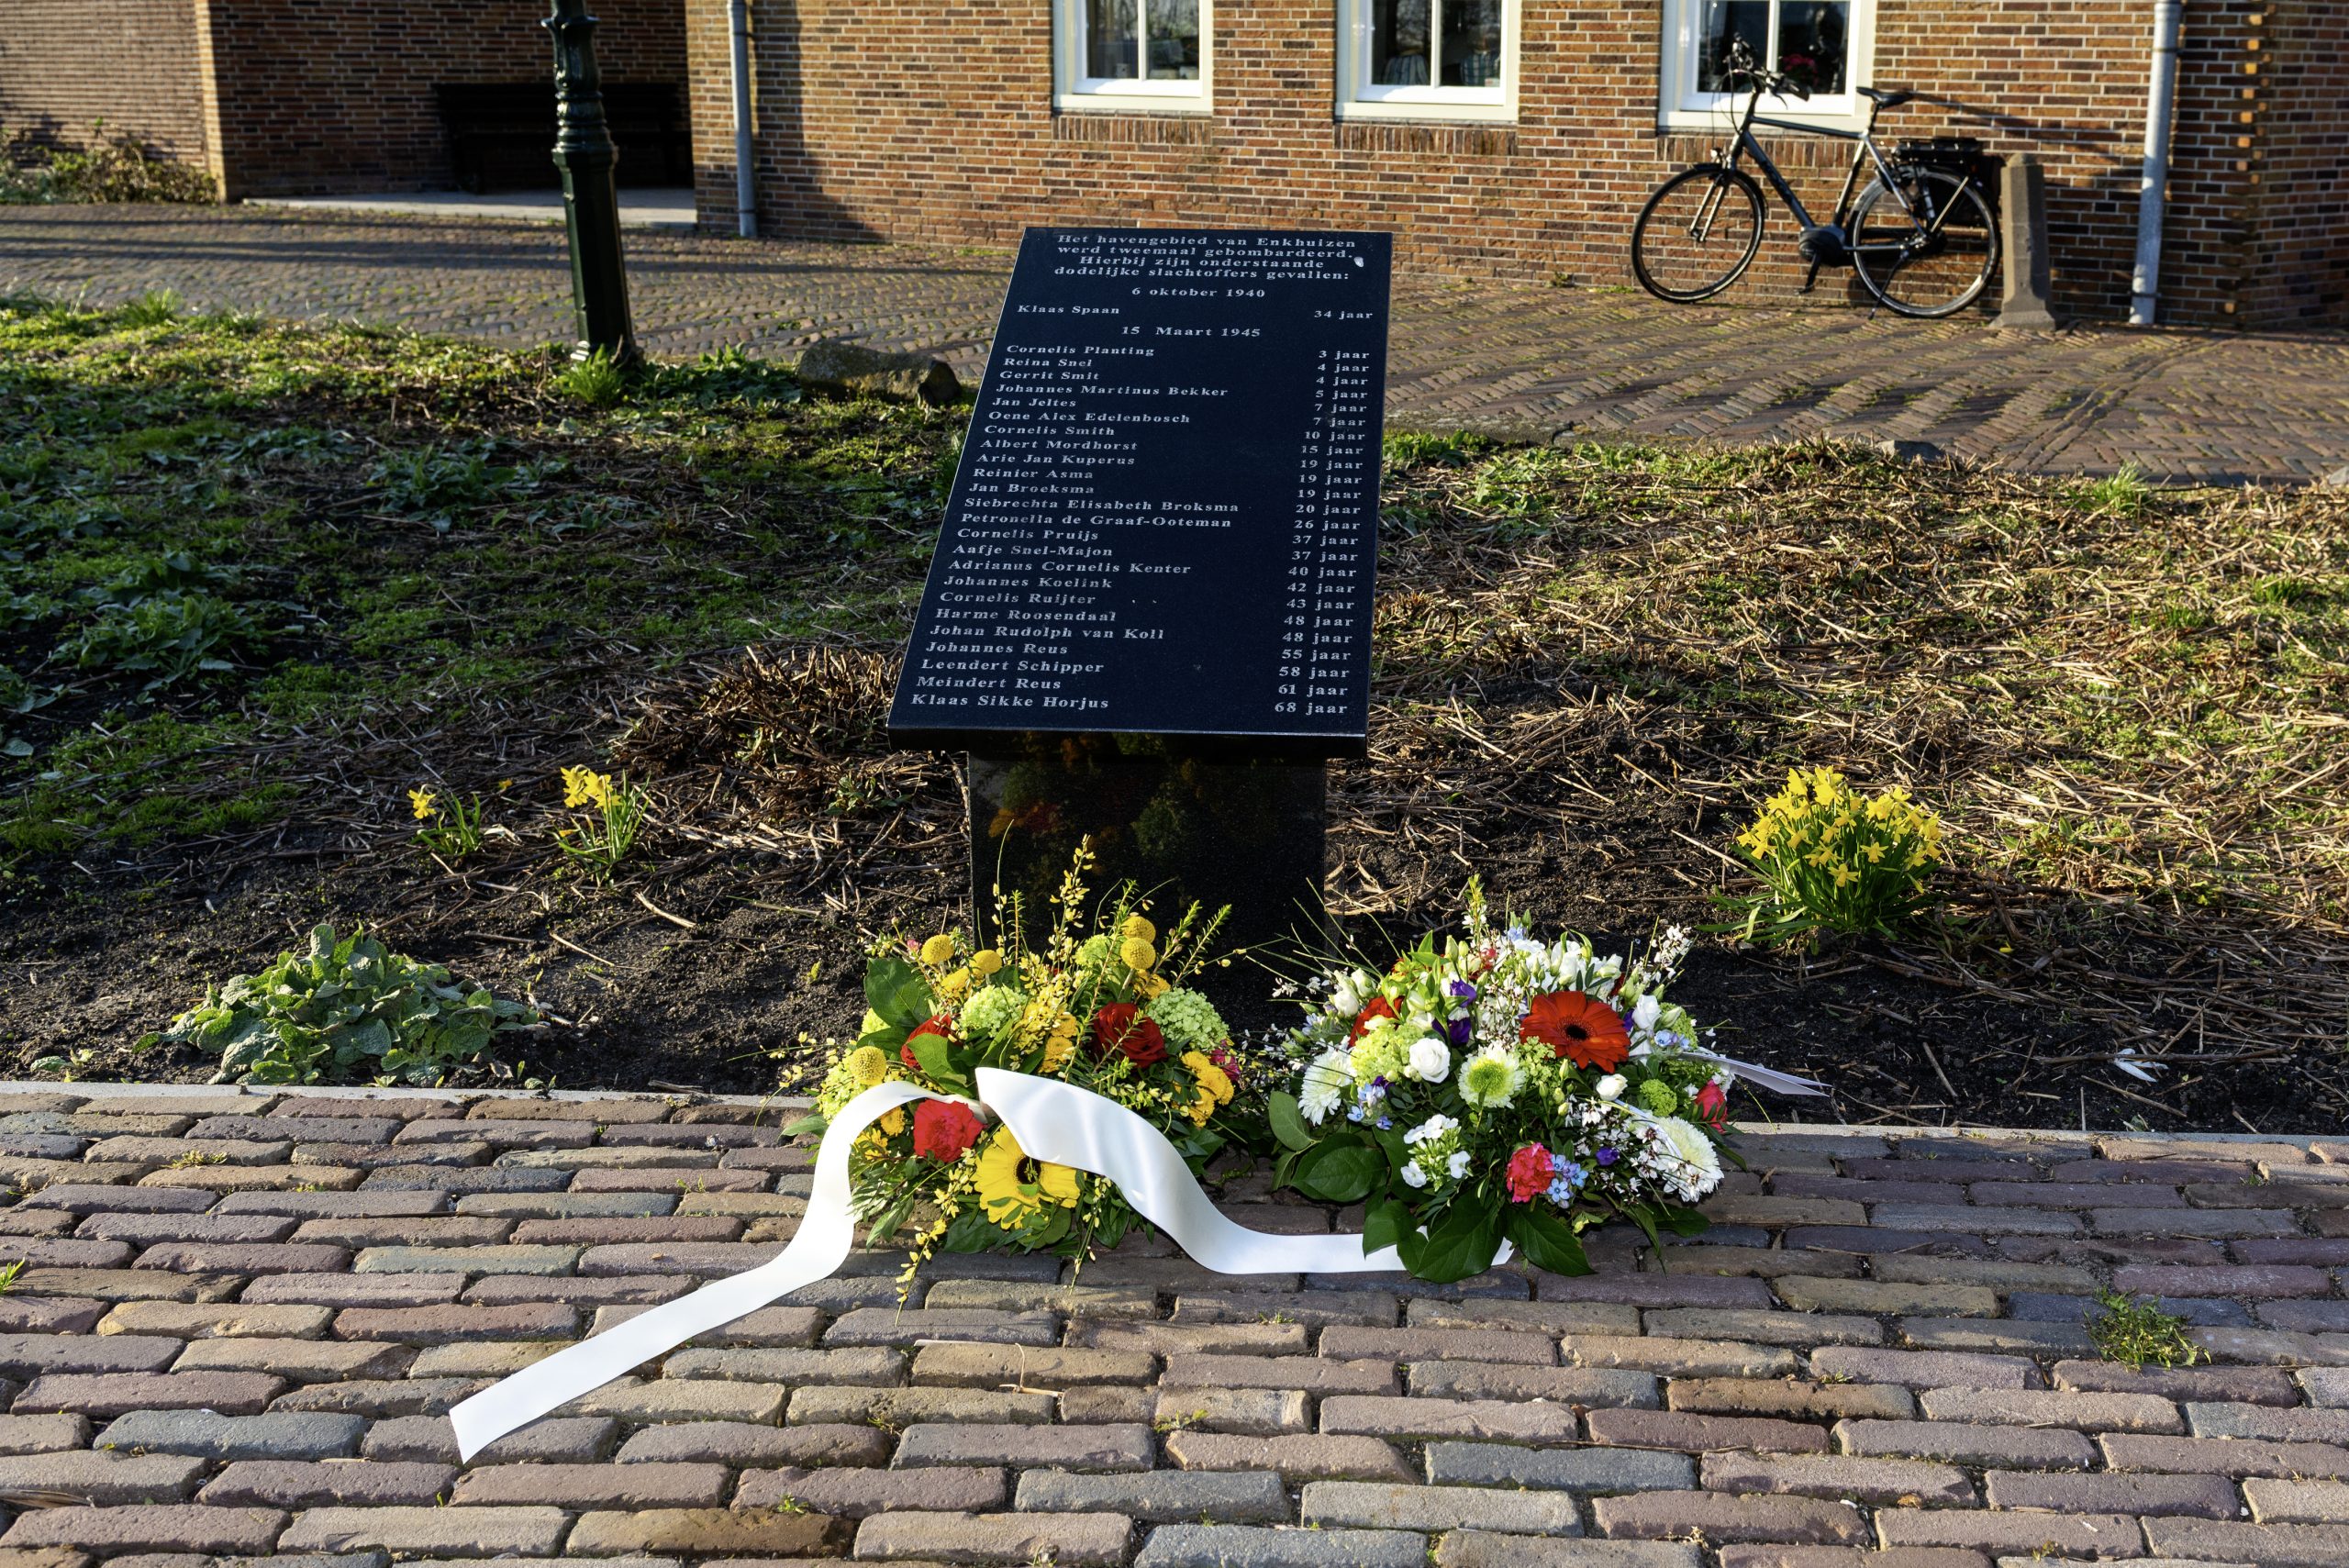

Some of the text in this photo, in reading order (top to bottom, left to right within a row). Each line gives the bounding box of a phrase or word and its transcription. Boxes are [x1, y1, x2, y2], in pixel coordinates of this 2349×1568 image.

[1057, 234, 1089, 243] Het
[1097, 235, 1208, 246] havengebied
[1256, 238, 1355, 248] Enkhuizen
[1057, 245, 1353, 259] werd tweemaal gebombardeerd.
[1078, 255, 1324, 269] Hierbij zijn onderstaande
[1053, 266, 1349, 281] dodelijke slachtoffers gevallen:
[1131, 286, 1265, 298] 6 oktober 1940
[1017, 305, 1374, 320] Klaas Spaan 34 jaar
[1121, 326, 1261, 338] 15 Maart 1945
[1006, 344, 1370, 361] Cornelis Planting 3 jaar
[1003, 357, 1370, 373] Reina Snel 4 jaar
[999, 370, 1369, 387] Gerrit Smit 4 jaar
[996, 384, 1368, 400] Johannes Martinus Bekker 5 jaar
[992, 397, 1367, 414] Jan Jeltes 7 jaar
[988, 411, 1366, 428] Oene Alex Edelenbosch 7 jaar
[984, 425, 1365, 442] Cornelis Smith 10 jaar
[979, 439, 1364, 456] Albert Mordhorst 15 jaar
[975, 453, 1364, 471] Arie Jan Kuperus 19 jaar
[972, 468, 1363, 486] Reinier Asma 19 jaar
[968, 483, 1362, 501] Jan Broeksma 19 jaar
[963, 497, 1361, 516] Siebrechta Elisabeth Broksma 20 jaar
[961, 513, 1361, 531] Petronella de Graaf-Ooteman 26 jaar
[957, 528, 1359, 547] Cornelis Pruijs 37 jaar
[952, 544, 1359, 563] Aafje Snel-Majon 37 jaar
[948, 560, 1357, 579] Adrianus Cornelis Kenter 40 jaar
[943, 575, 1355, 595] Johannes Koelink 42 jaar
[940, 591, 1355, 611] Cornelis Ruijter 43 jaar
[934, 607, 1354, 628] Harme Roosendaal 48 jaar
[930, 625, 1353, 645] Johan Rudolph van Koll 48 jaar
[925, 641, 1352, 662] Johannes Reus 55 jaar
[920, 658, 1350, 680] Leendert Schipper 58 jaar
[916, 675, 1349, 698] Meindert Reus 61 jaar
[910, 694, 1348, 716] Klaas Sikke Horjus 68 jaar
